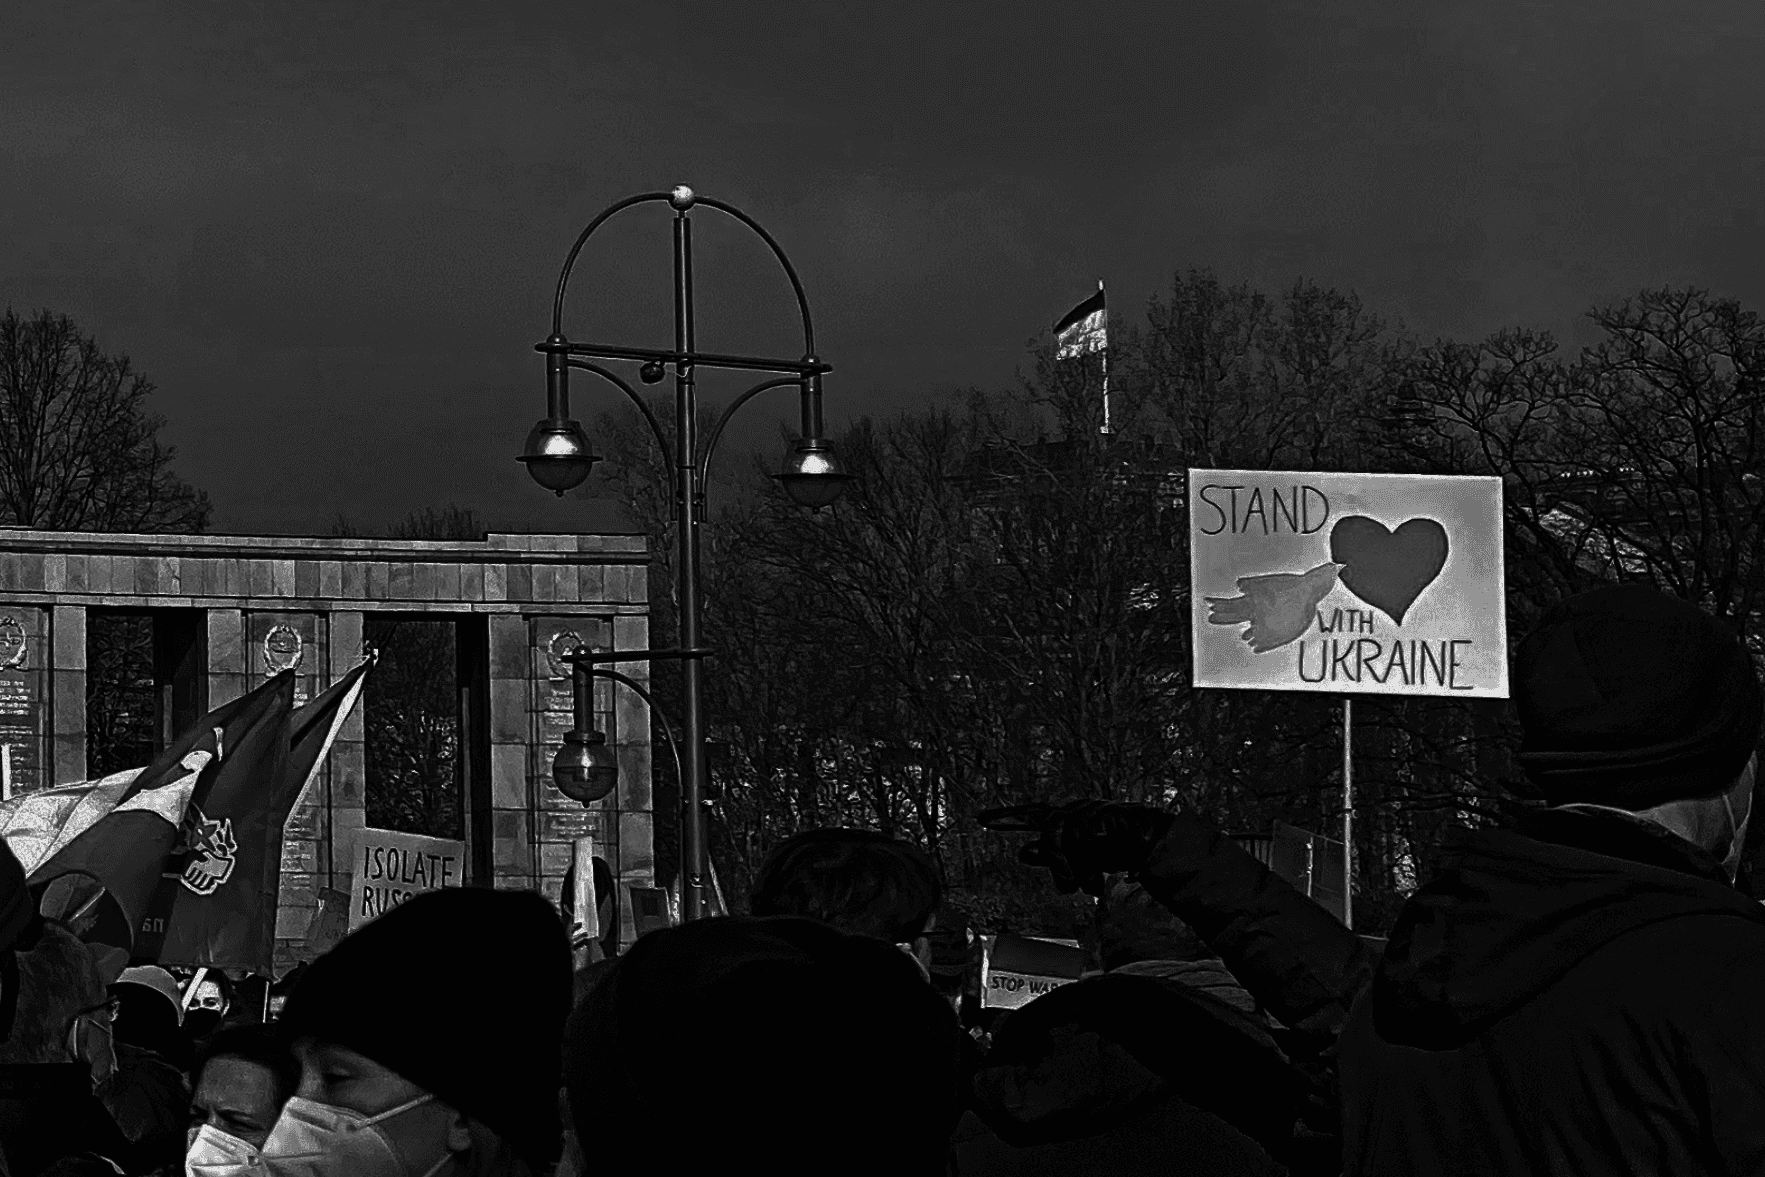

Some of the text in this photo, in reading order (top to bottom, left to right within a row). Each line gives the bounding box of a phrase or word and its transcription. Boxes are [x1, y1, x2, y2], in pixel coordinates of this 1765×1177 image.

[1199, 484, 1330, 535] STAND
[1317, 608, 1374, 634] WITH
[1299, 639, 1473, 691] UKRAINE
[363, 846, 455, 889] ISOLATE
[992, 976, 1025, 992] STOP
